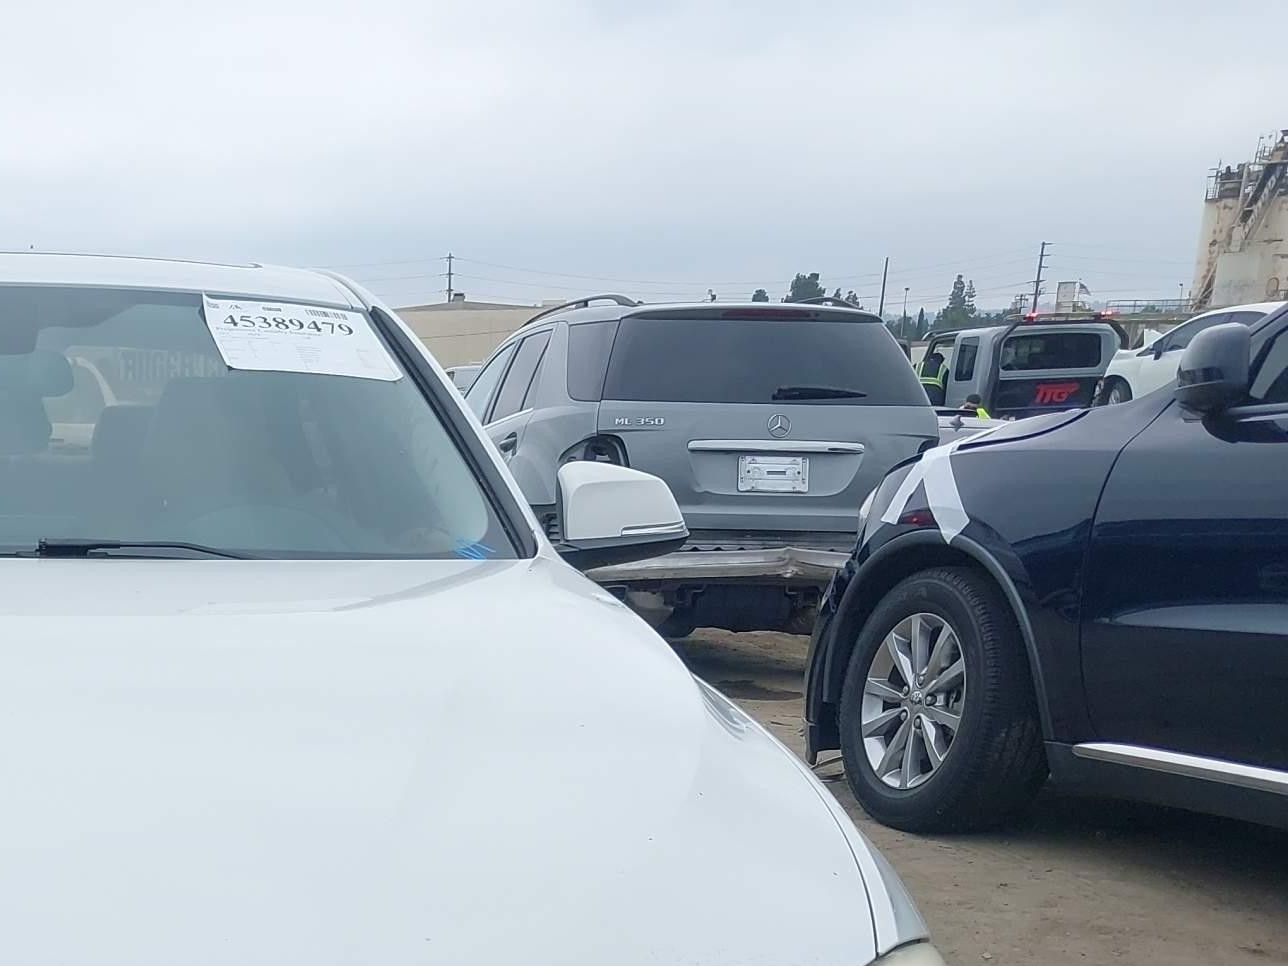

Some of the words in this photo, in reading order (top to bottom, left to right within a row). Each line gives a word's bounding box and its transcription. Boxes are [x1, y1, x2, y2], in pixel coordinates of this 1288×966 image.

[223, 314, 354, 337] 45389479
[615, 417, 632, 425] ML
[636, 417, 665, 425] 350
